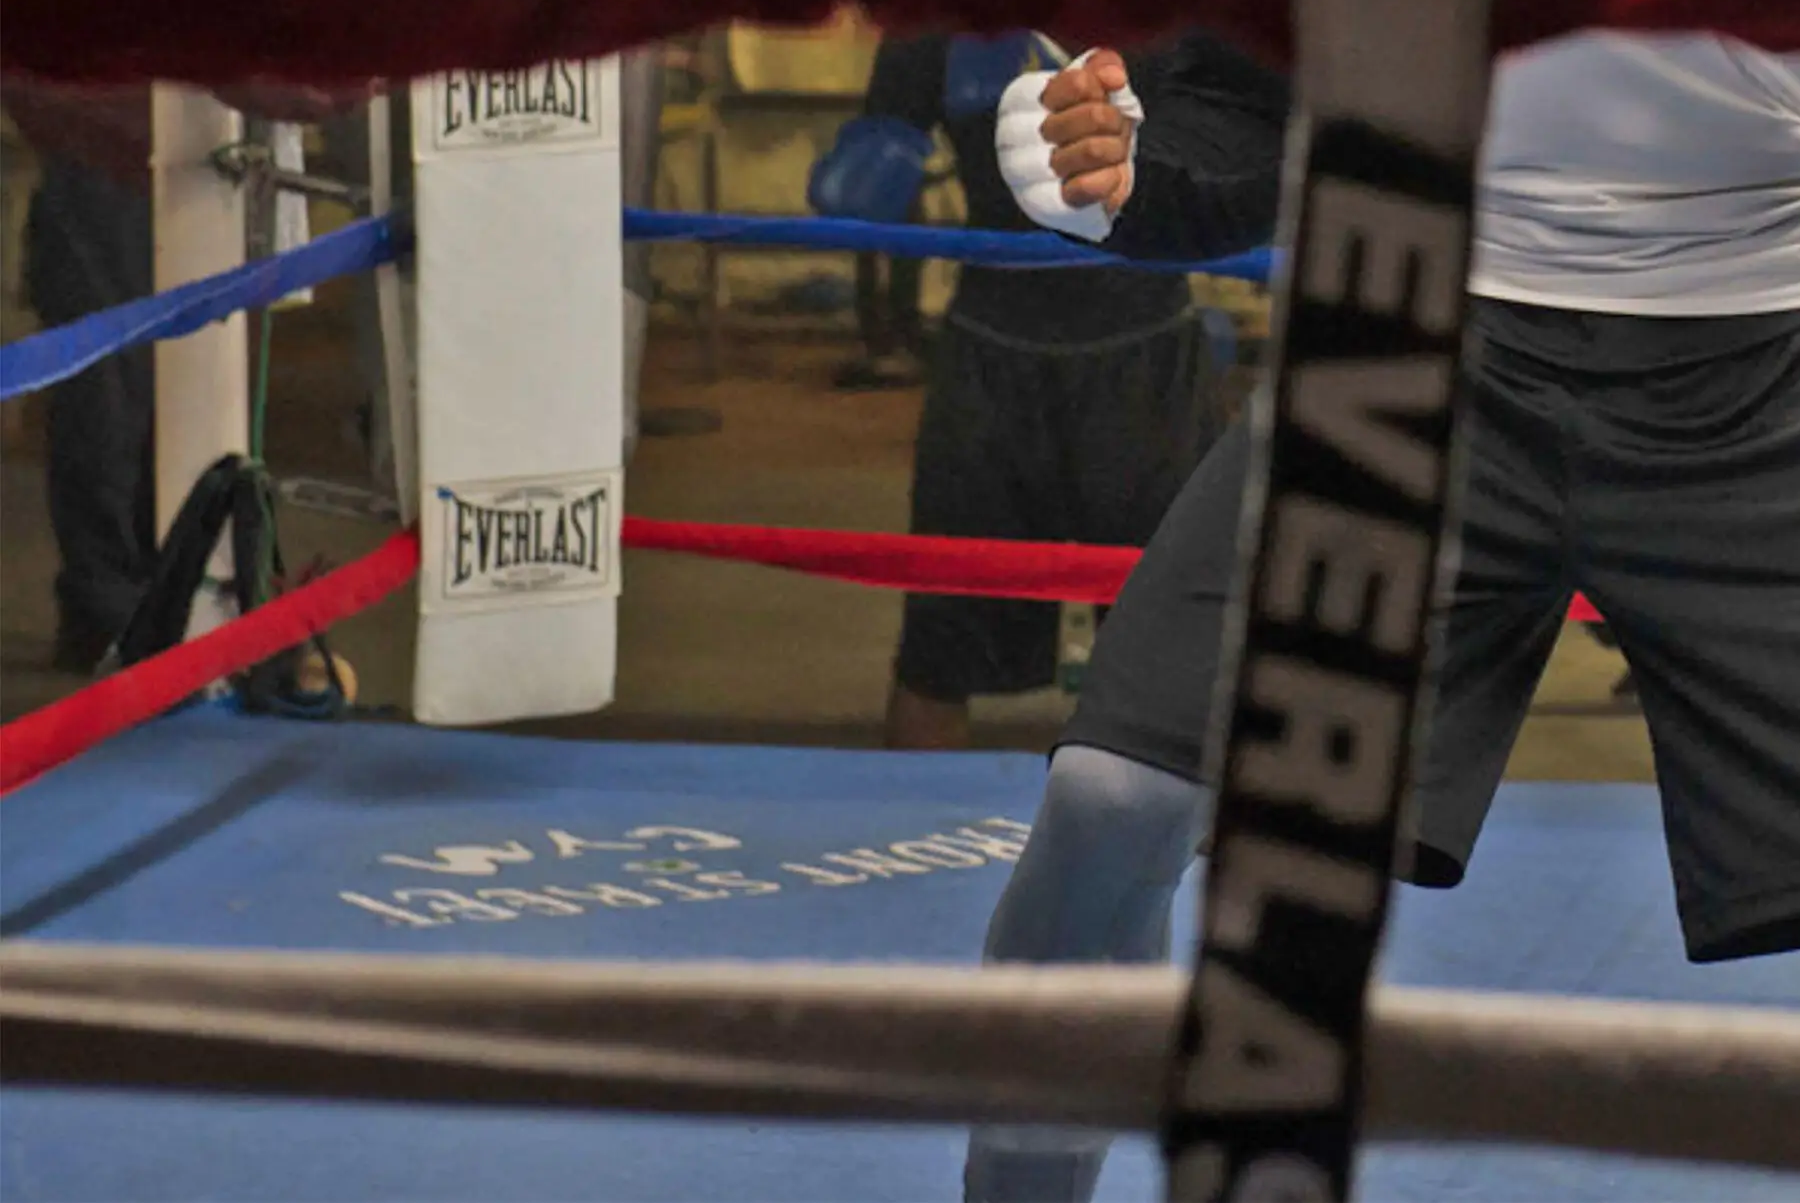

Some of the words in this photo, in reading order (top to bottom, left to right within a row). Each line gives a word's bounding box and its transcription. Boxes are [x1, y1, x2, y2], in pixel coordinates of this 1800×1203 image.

[443, 59, 592, 138] EVERLAST
[452, 488, 606, 586] EVERLAST
[378, 825, 743, 876] GYM
[338, 870, 781, 928] STREET
